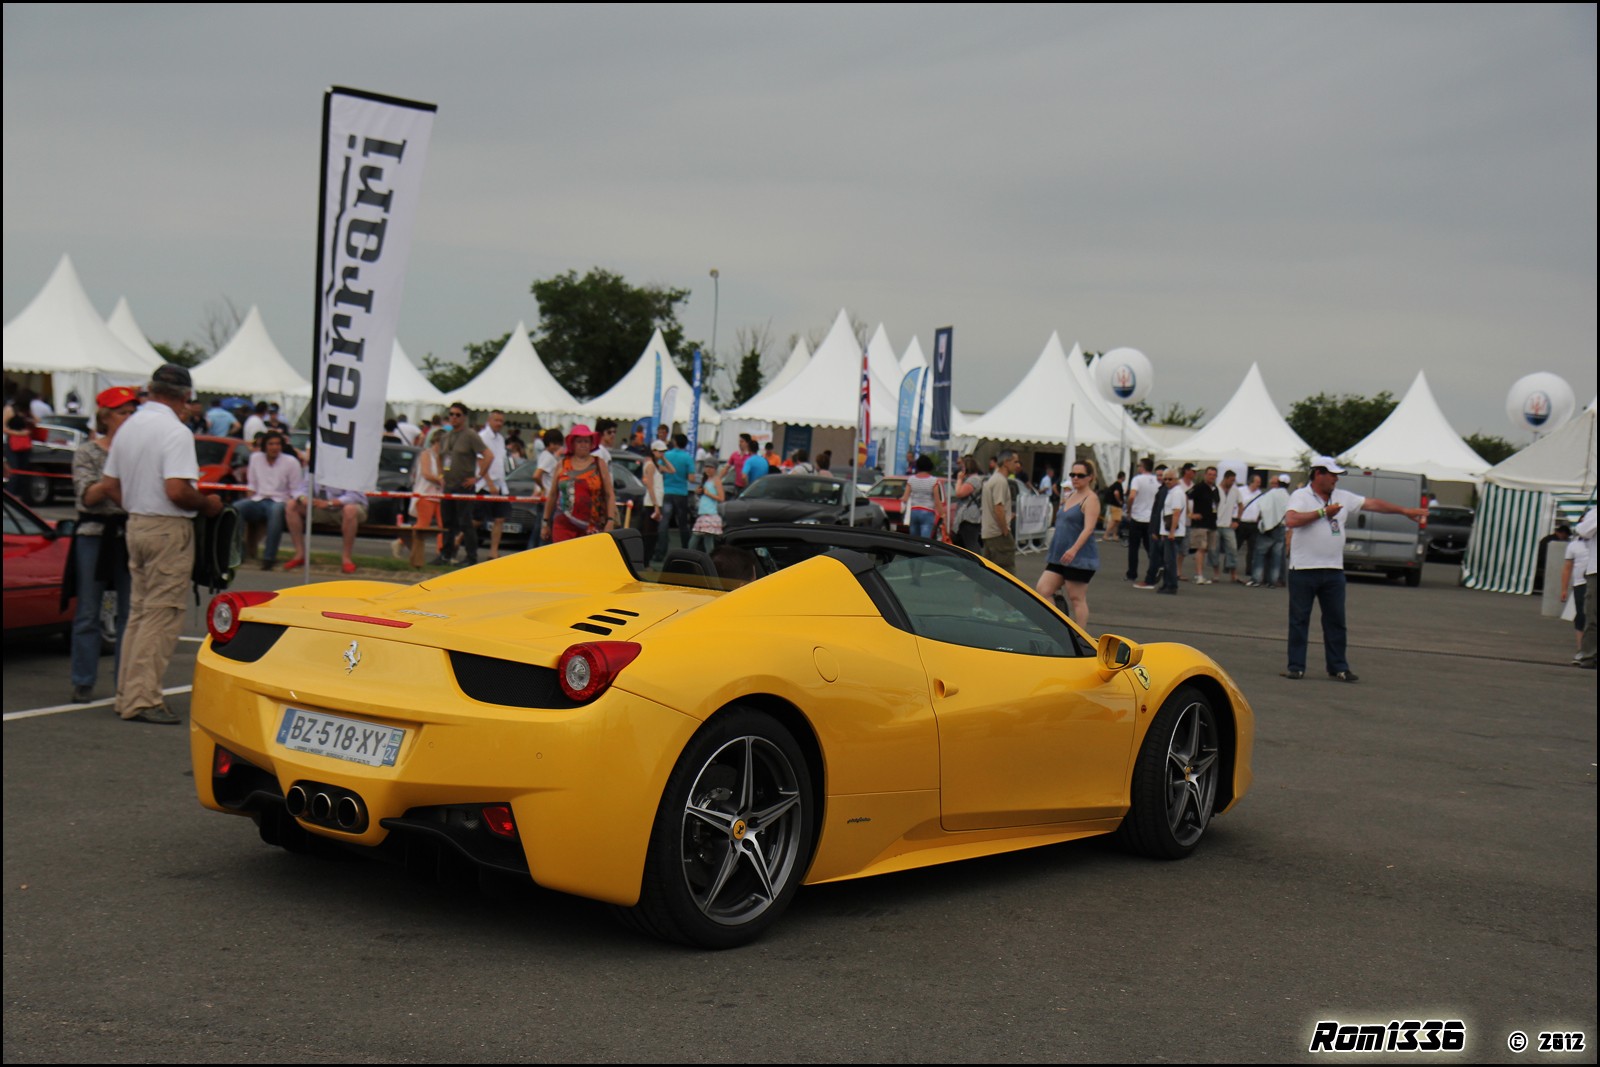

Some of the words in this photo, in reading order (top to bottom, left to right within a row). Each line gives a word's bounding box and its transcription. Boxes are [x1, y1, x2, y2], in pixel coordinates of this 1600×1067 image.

[319, 134, 408, 459] Ferrari
[290, 715, 387, 757] BZ-518-XY
[383, 747, 395, 762] 24
